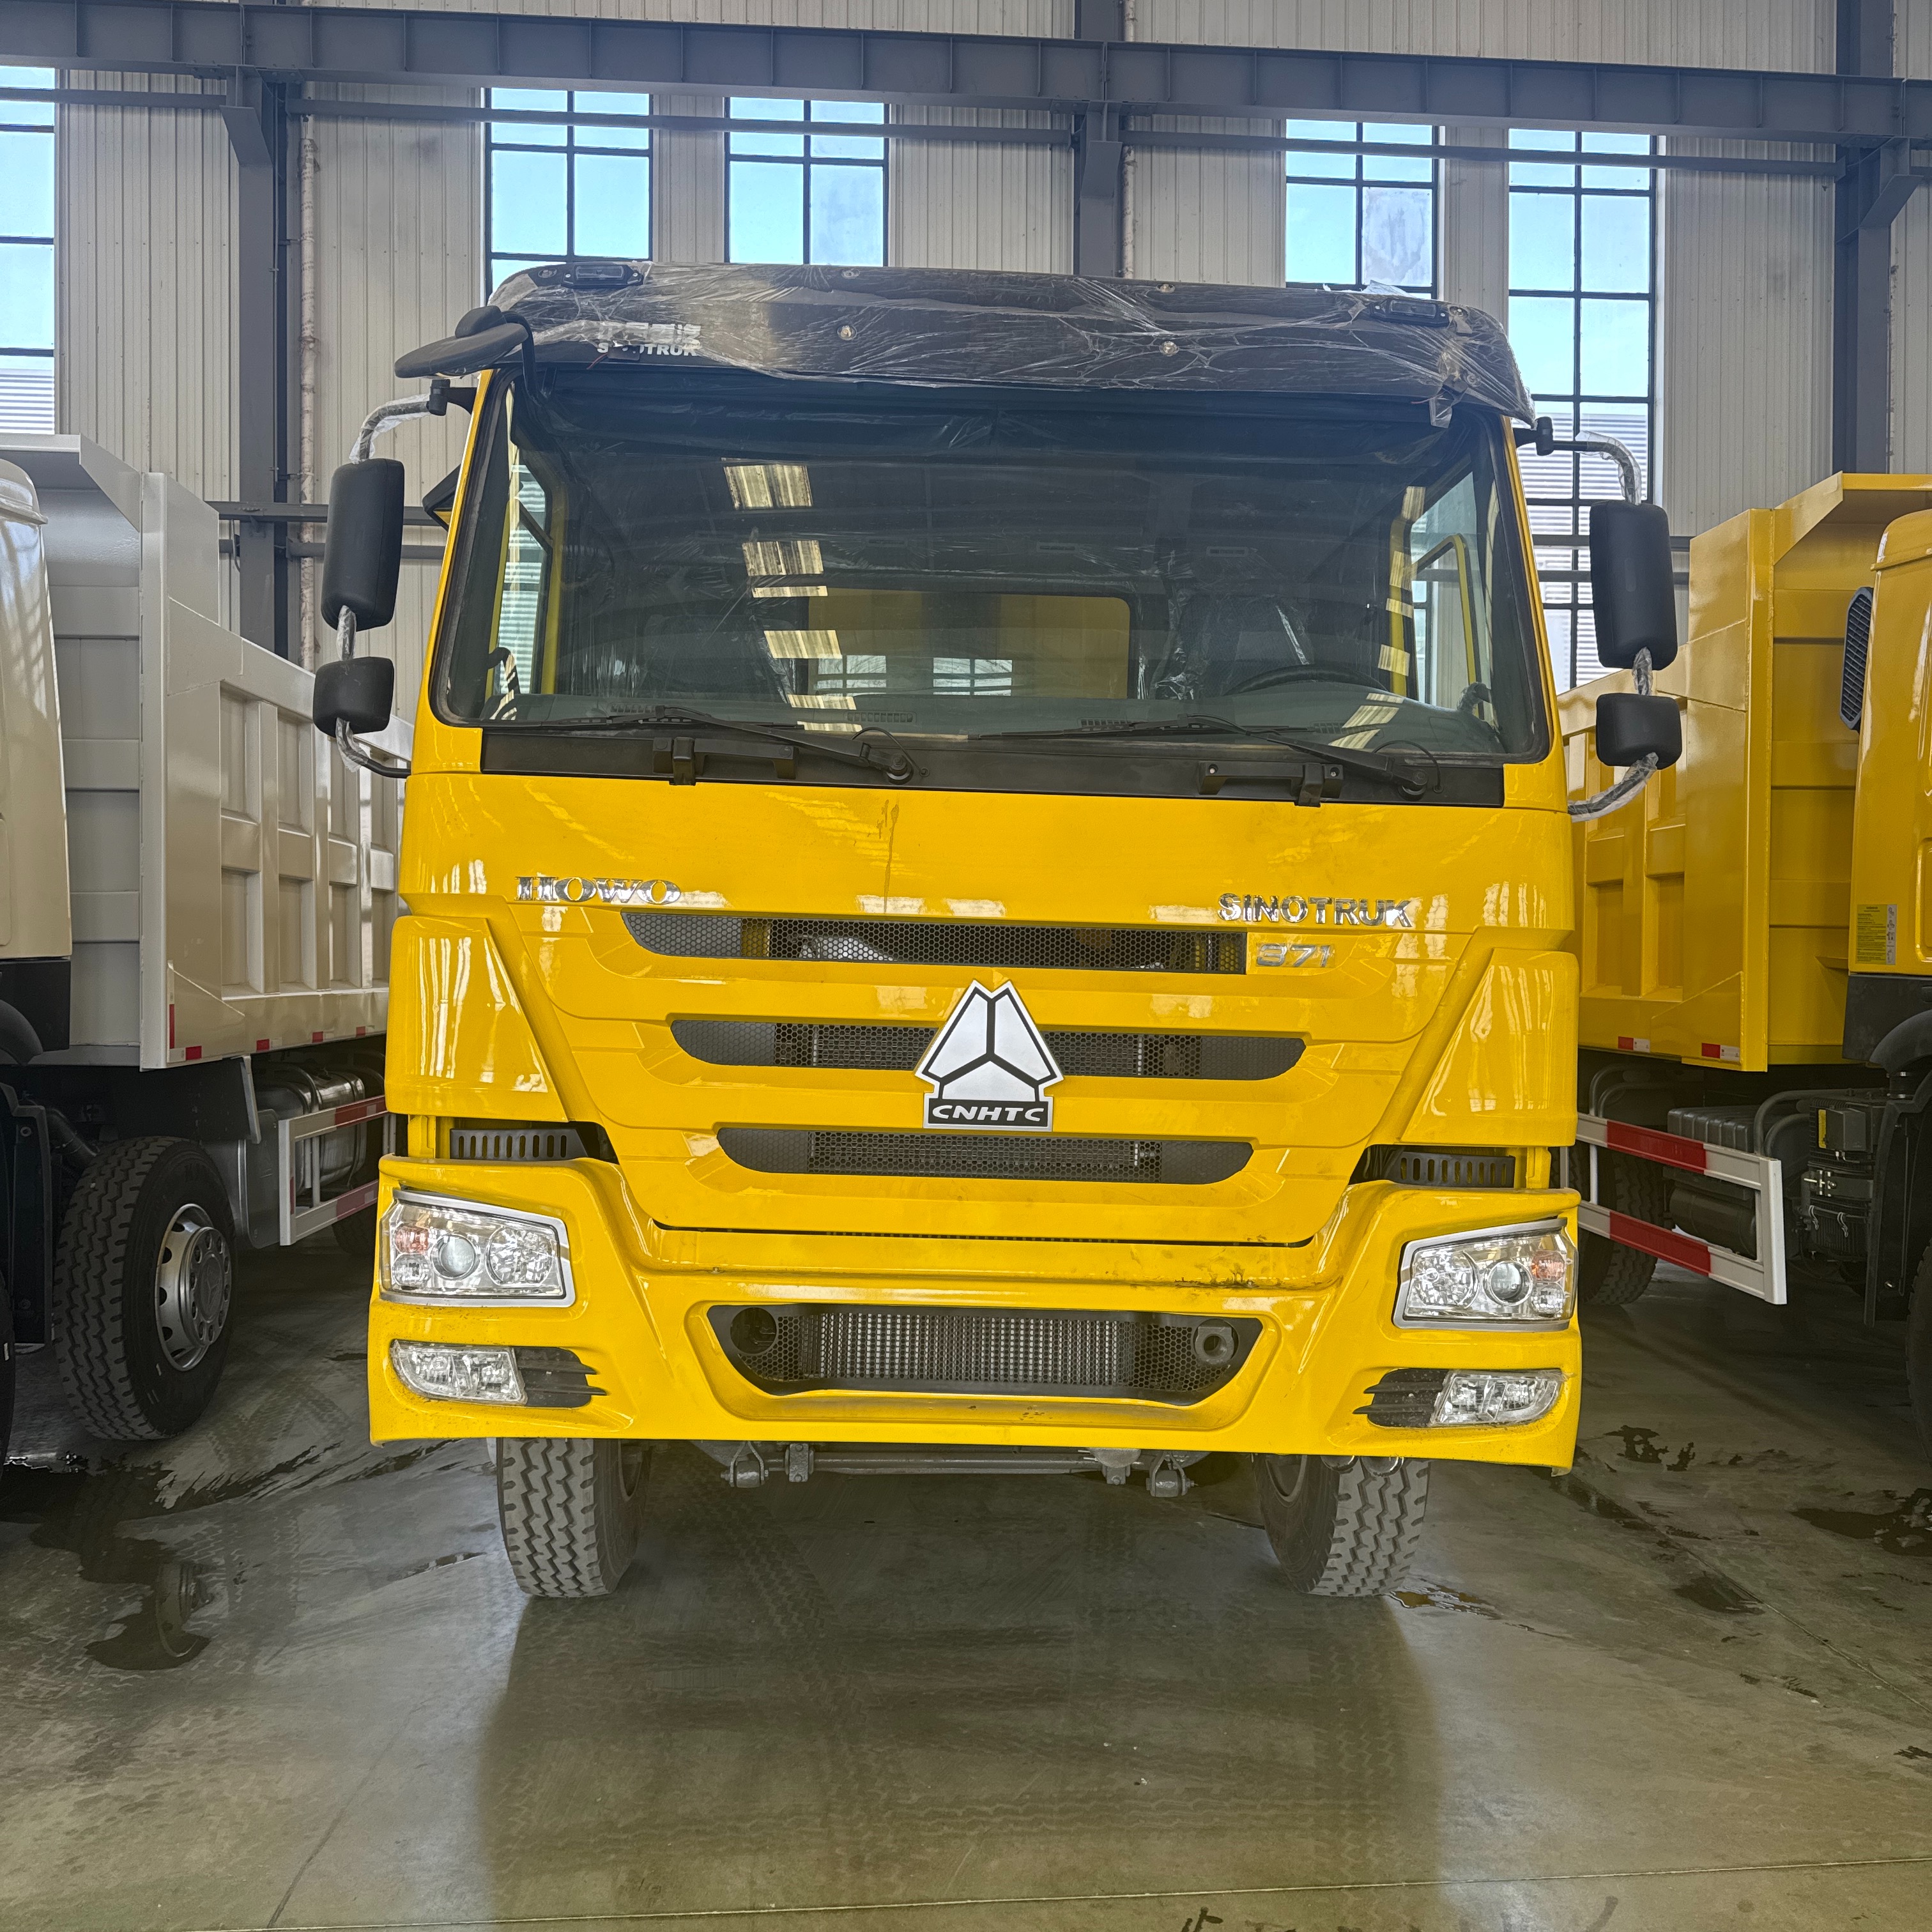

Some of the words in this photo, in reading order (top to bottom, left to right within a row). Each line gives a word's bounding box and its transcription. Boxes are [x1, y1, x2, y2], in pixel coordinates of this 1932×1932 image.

[597, 342, 698, 356] STRUK
[514, 877, 681, 905] HOWO
[1217, 893, 1413, 927] SINOTRUK
[1256, 943, 1331, 967] 371
[932, 1105, 1045, 1122] CNHTC
